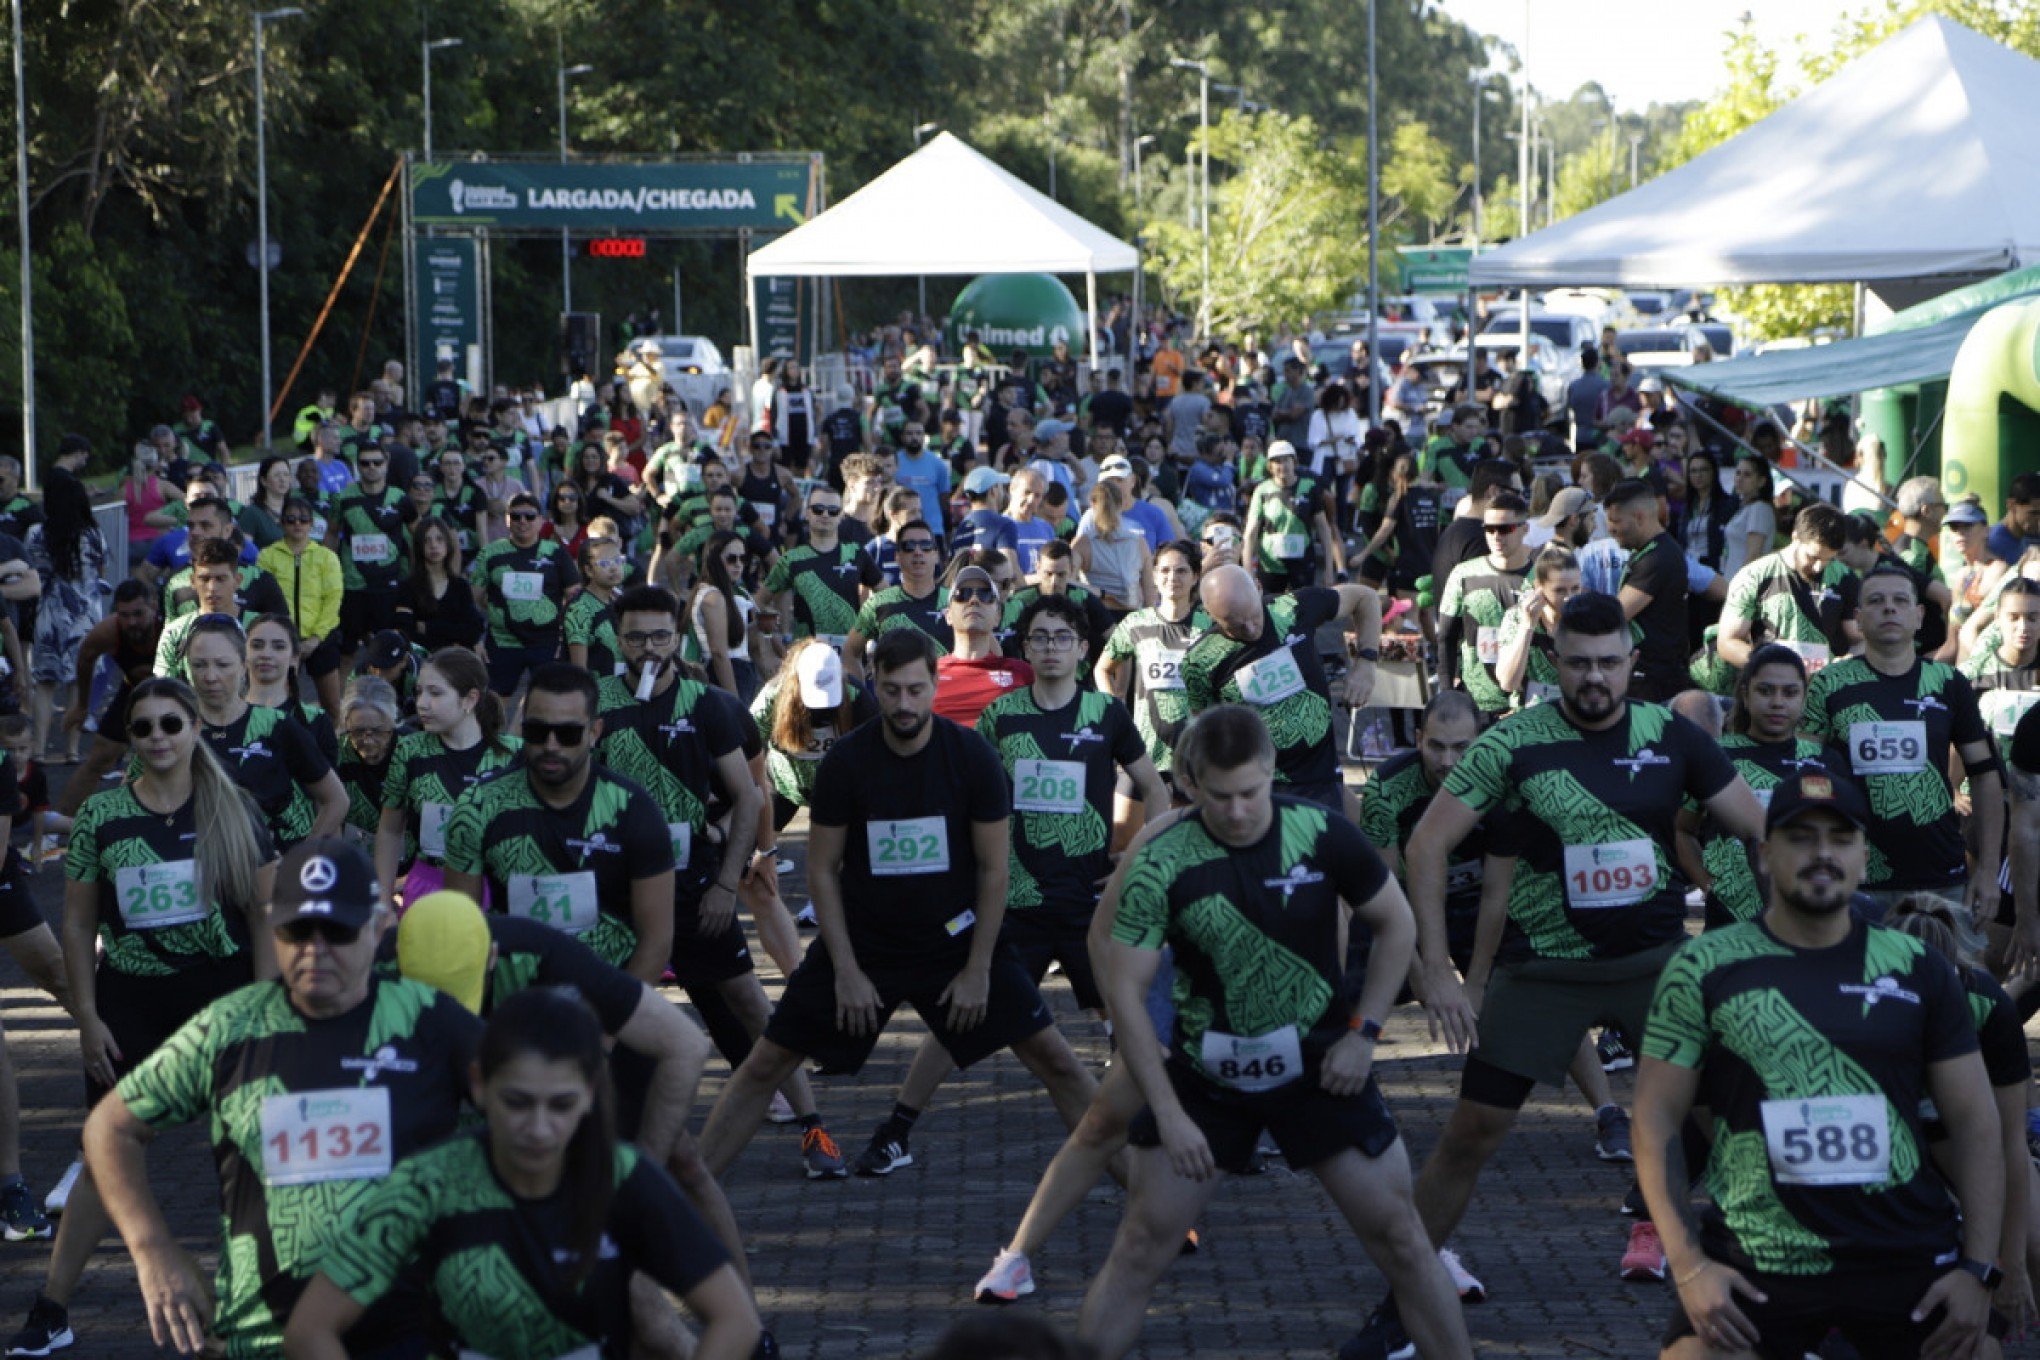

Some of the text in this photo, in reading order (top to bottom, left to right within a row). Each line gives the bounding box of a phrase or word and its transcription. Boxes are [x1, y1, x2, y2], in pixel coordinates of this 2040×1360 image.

[527, 186, 756, 213] LARGADA/CHEGADA
[512, 580, 534, 595] 20
[1247, 665, 1297, 697] 125
[1858, 737, 1919, 762] 659
[1021, 776, 1077, 802] 208
[877, 835, 941, 863] 292
[1572, 864, 1653, 894] 1093
[126, 881, 196, 914] 263
[530, 894, 572, 923] 41
[1220, 1054, 1286, 1079] 846
[269, 1121, 383, 1164] 1132
[1783, 1123, 1879, 1164] 588
